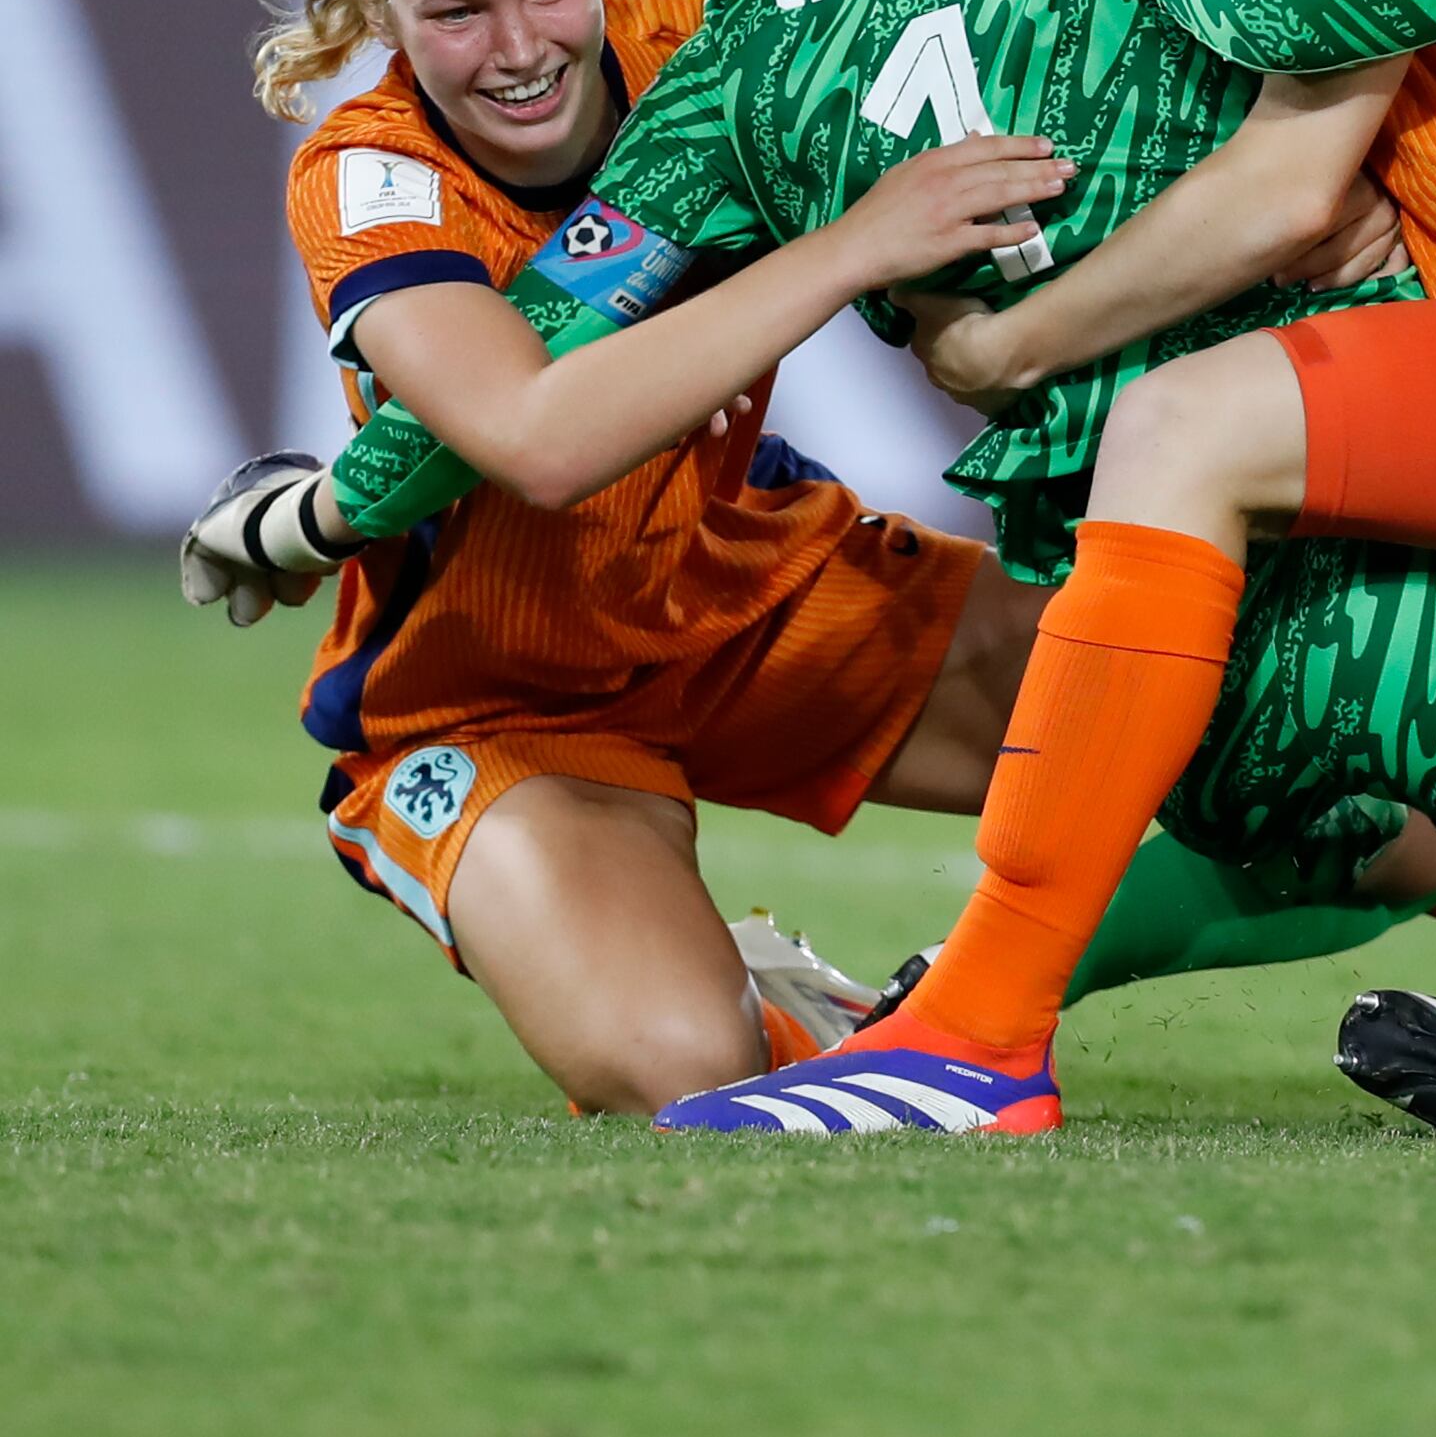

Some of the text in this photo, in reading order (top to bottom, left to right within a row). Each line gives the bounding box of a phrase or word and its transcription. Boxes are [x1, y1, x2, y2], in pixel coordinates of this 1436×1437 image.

[860, 4, 1055, 282] 1
[614, 295, 643, 315] FIFA
[945, 1064, 993, 1084] PREDATOR
